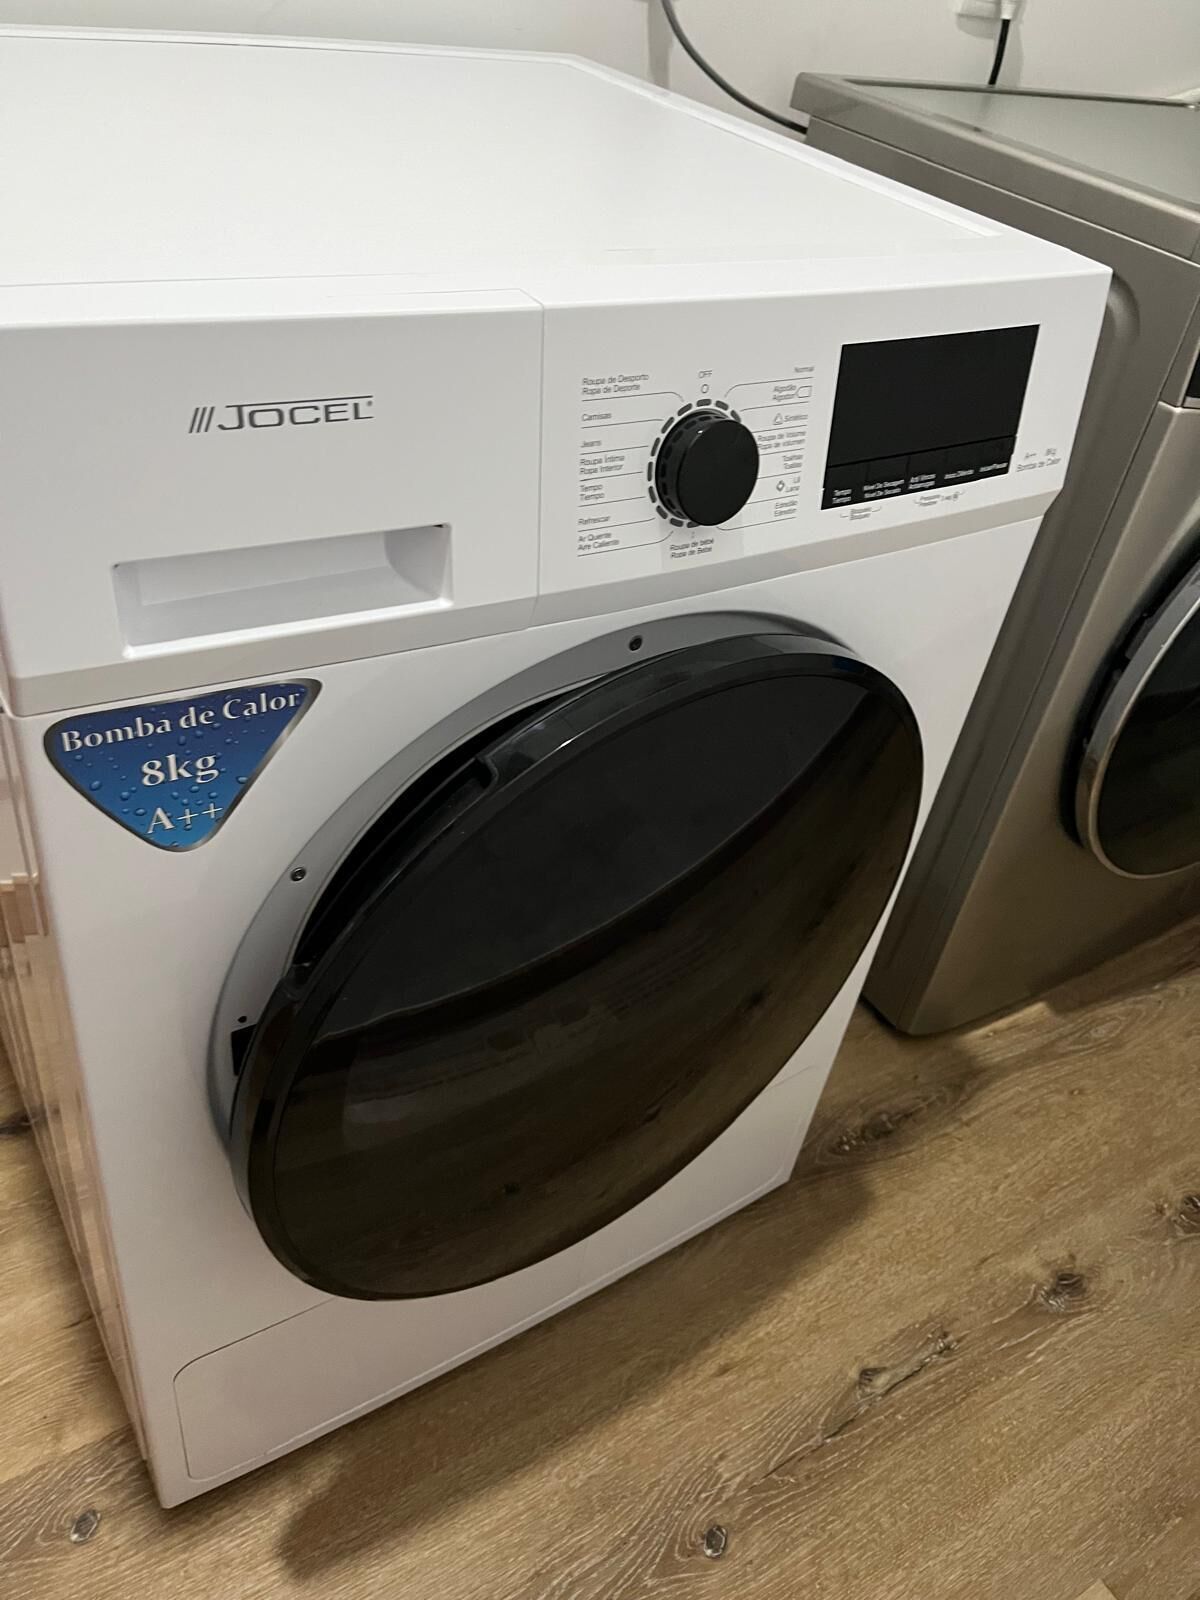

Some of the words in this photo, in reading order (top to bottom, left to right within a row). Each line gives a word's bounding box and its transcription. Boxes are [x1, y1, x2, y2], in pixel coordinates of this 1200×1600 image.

[582, 377, 606, 386] Roupa
[608, 376, 617, 384] de
[618, 373, 649, 383] Desporto
[698, 370, 713, 379] OFF
[582, 387, 602, 396] Ropa
[603, 386, 612, 394] de
[613, 384, 641, 394] Deporte
[217, 395, 374, 431] JOCEL
[581, 412, 612, 422] Camisas
[580, 440, 602, 448] Jeans
[578, 515, 611, 525] Refrescar
[578, 535, 587, 543] Ar
[588, 532, 612, 542] Quente
[592, 538, 620, 549] Caliente
[61, 717, 172, 752] Bomba
[179, 706, 215, 729] de
[222, 692, 300, 720] Calor
[140, 753, 220, 786] 8kg
[147, 801, 223, 834] A++
